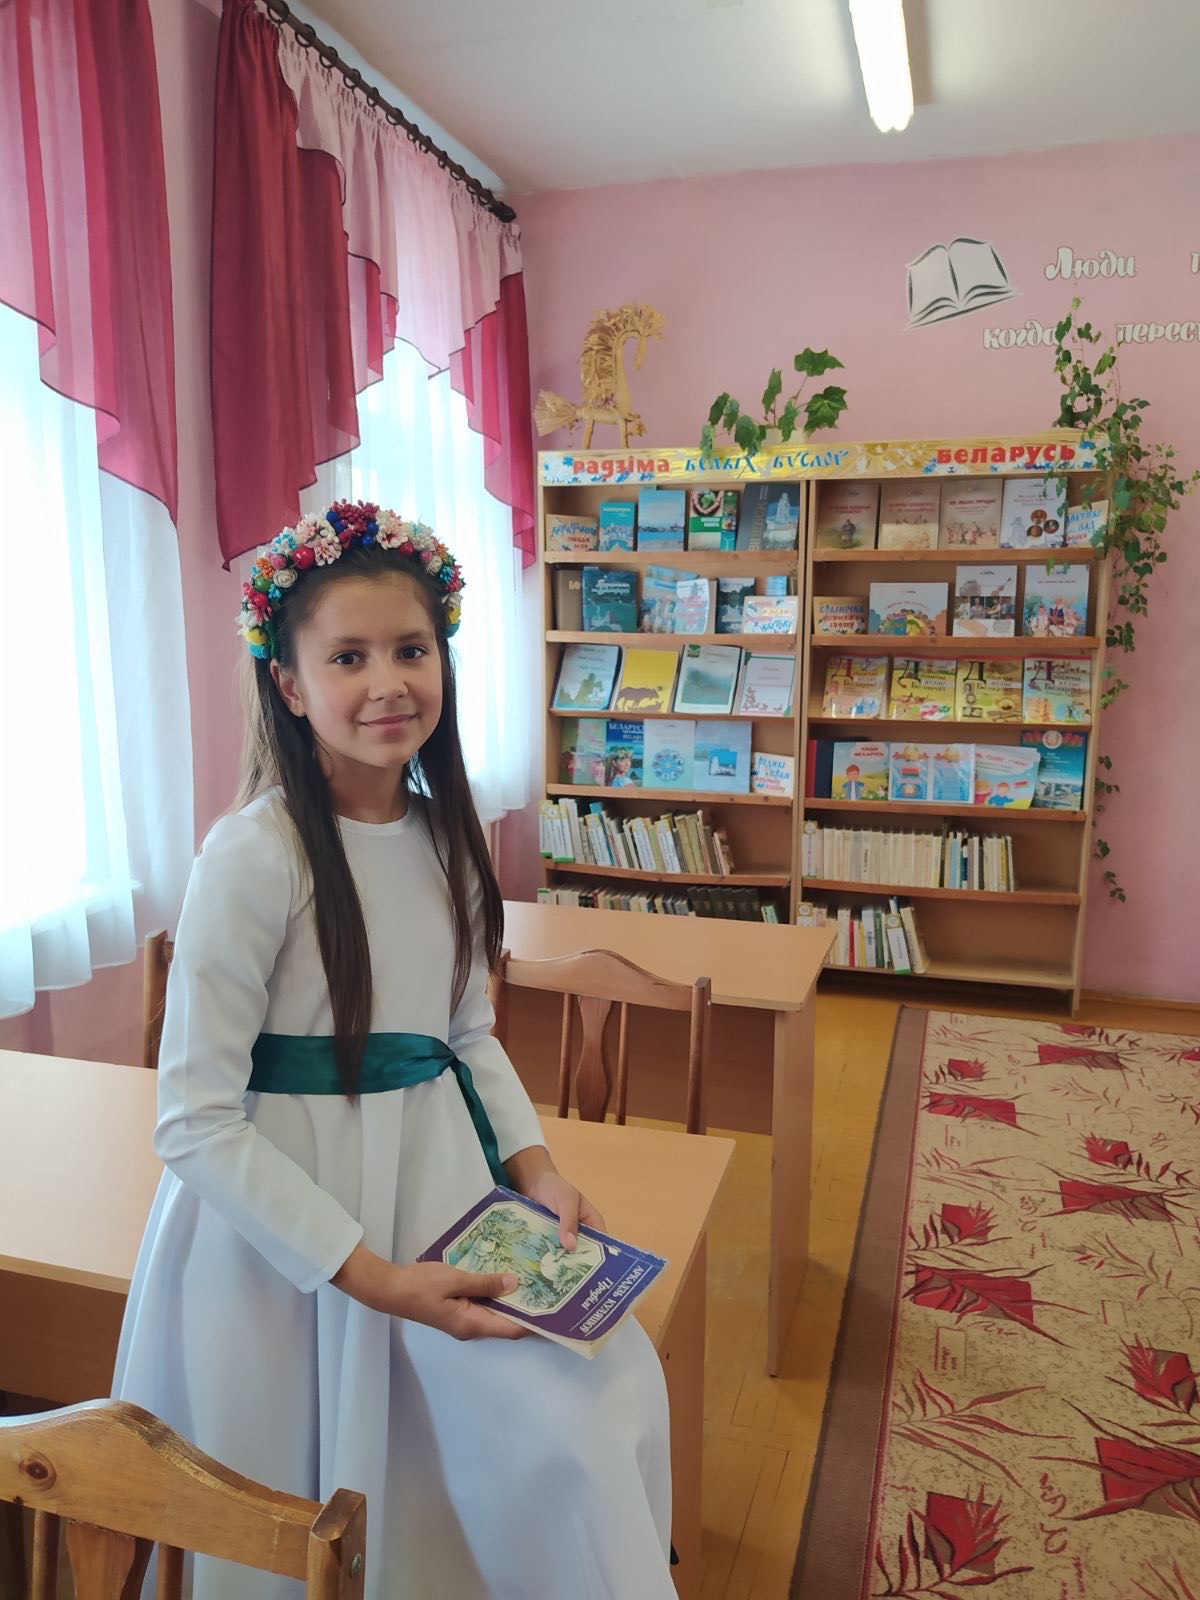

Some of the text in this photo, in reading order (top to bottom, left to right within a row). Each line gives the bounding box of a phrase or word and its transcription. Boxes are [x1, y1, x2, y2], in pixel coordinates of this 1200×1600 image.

[1044, 247, 1137, 280] Люди
[983, 319, 1200, 349] когда перес
[609, 722, 644, 731] БЕЛАРУС
[579, 1265, 645, 1333] АРКАДЗЬ КУЛЯШОЎ
[581, 1276, 614, 1311] Профілі
